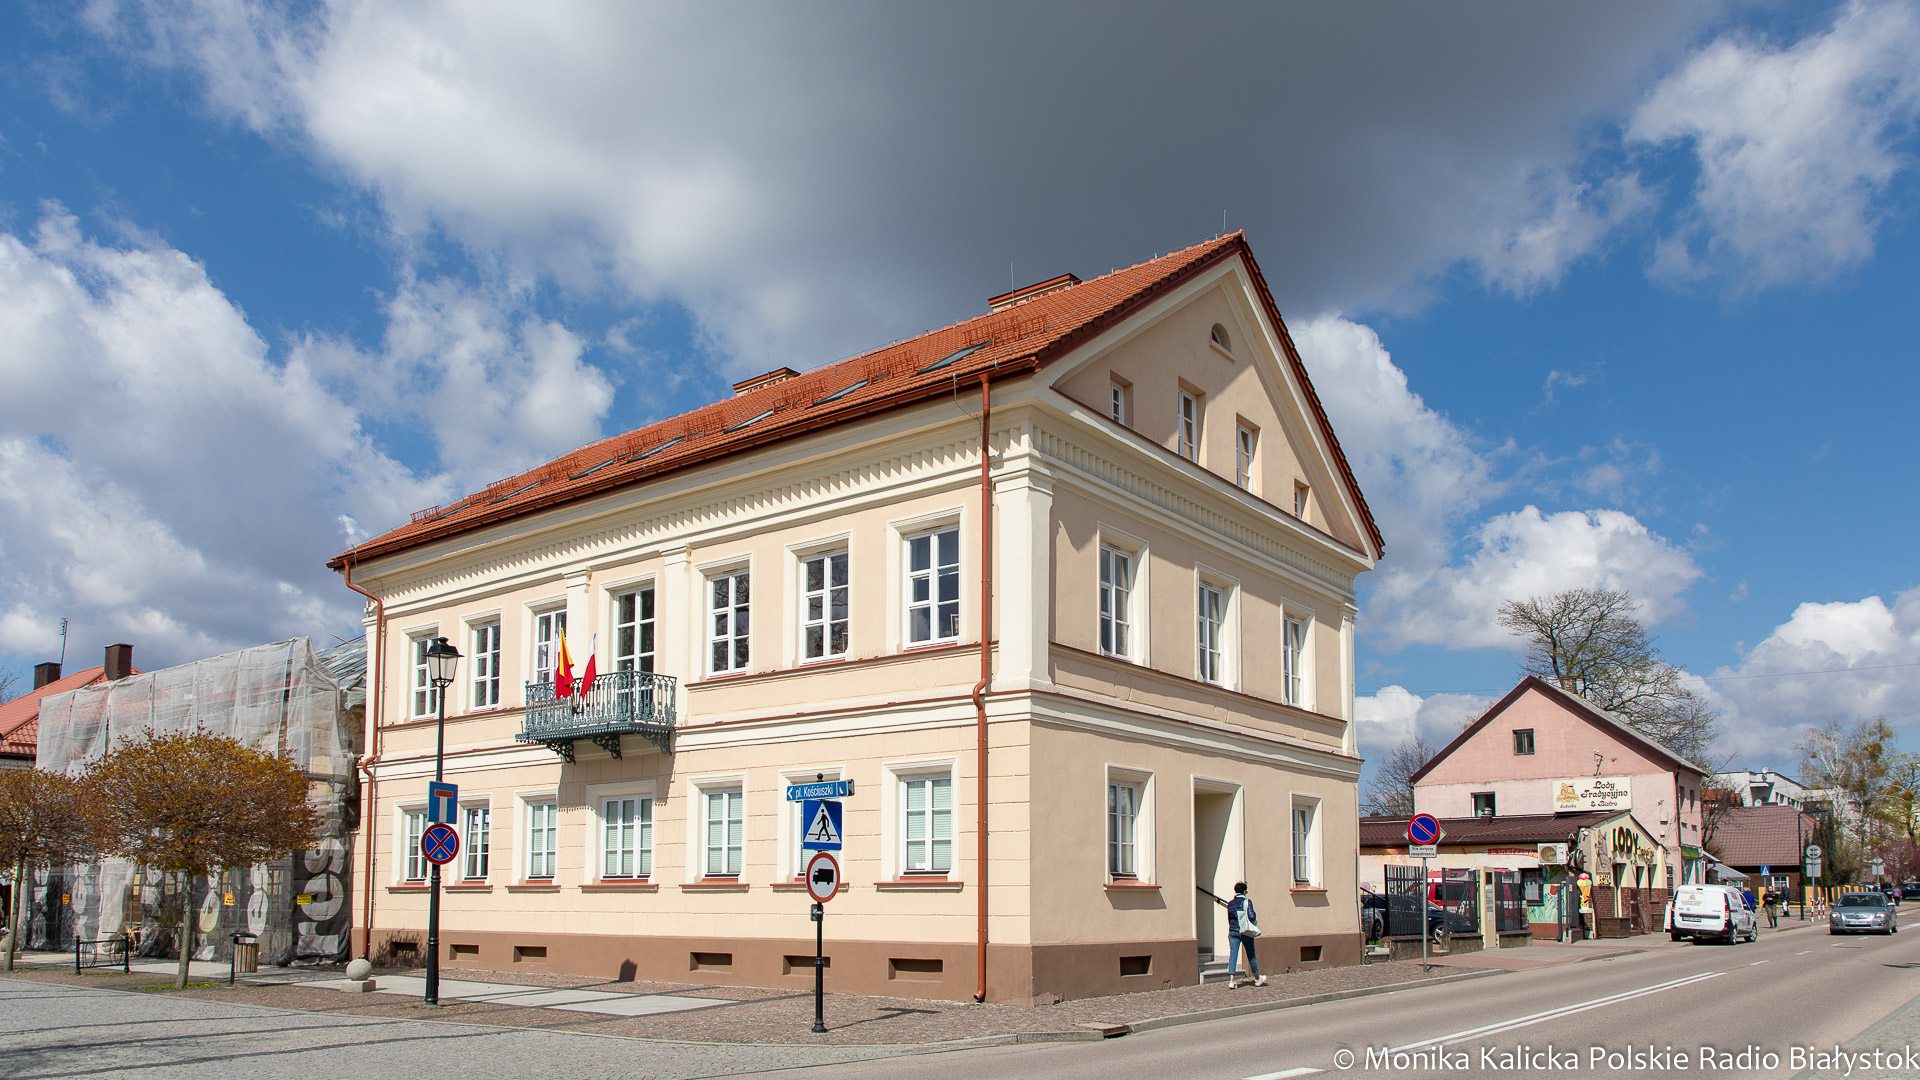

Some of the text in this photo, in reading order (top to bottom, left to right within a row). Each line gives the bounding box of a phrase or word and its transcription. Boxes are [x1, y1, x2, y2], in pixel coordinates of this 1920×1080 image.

[804, 785, 833, 797] Kościuszki
[1593, 780, 1615, 791] Lody
[1580, 789, 1628, 799] Tradycyjne
[1611, 826, 1638, 854] LODY
